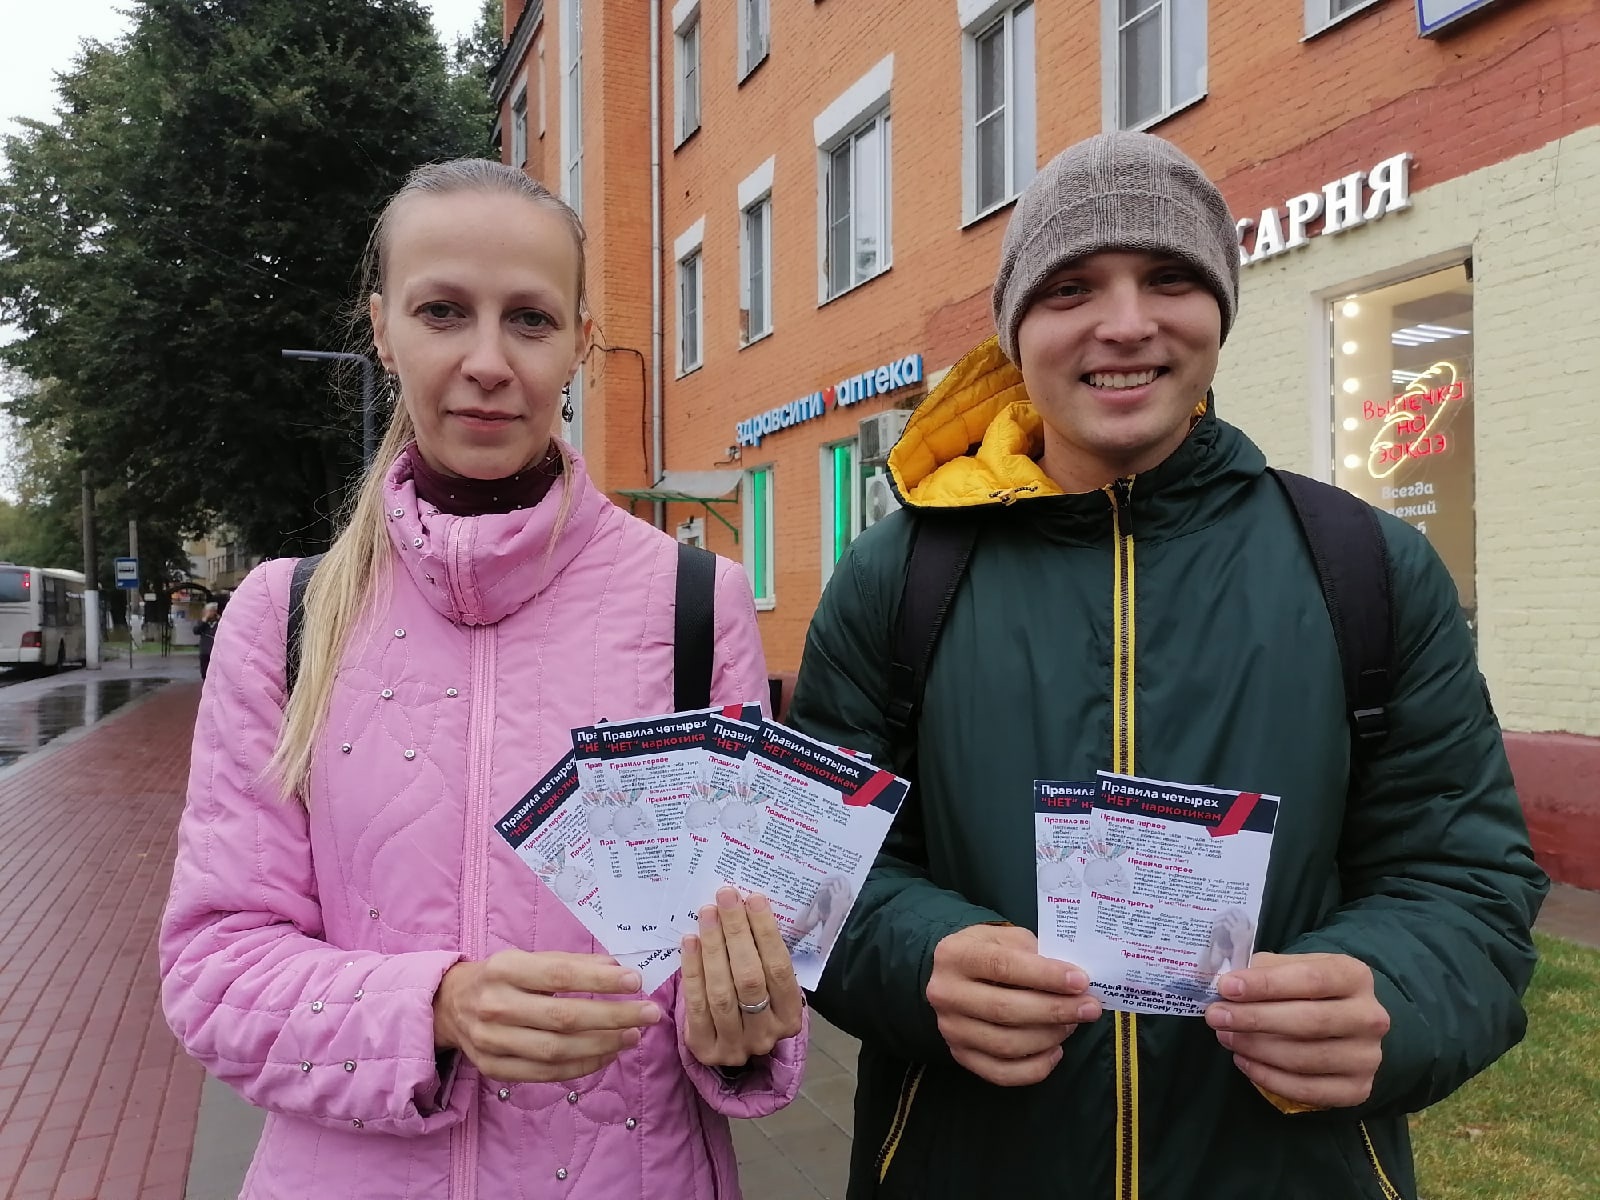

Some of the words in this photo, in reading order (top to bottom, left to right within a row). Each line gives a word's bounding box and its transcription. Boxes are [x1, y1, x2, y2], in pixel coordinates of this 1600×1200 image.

[736, 391, 825, 447] здравсити
[837, 353, 923, 407] аптека
[1363, 381, 1465, 421] Выпечка
[1397, 414, 1427, 436] на
[1382, 482, 1434, 499] Всегда
[602, 727, 654, 742] Правила
[656, 719, 708, 733] четырех
[579, 741, 599, 753] "НЕ
[606, 740, 639, 753] "НЕТ"
[641, 733, 706, 750] наркотика
[712, 737, 746, 753] "НЕТ"
[762, 727, 811, 757] Правила
[813, 750, 860, 779] четырех
[761, 739, 791, 759] "НЕТ"
[792, 757, 858, 791] наркотикам
[1041, 784, 1095, 798] Правила
[1041, 797, 1078, 808] "НЕТ"
[1101, 780, 1159, 799] Правила
[1161, 792, 1219, 808] четырех
[501, 793, 540, 832] Правила
[509, 813, 535, 838] "НЕТ"
[537, 773, 578, 816] наркотик
[1101, 793, 1139, 807] "НЕТ"
[1141, 802, 1223, 822] наркотикам
[1089, 981, 1121, 992] аждый
